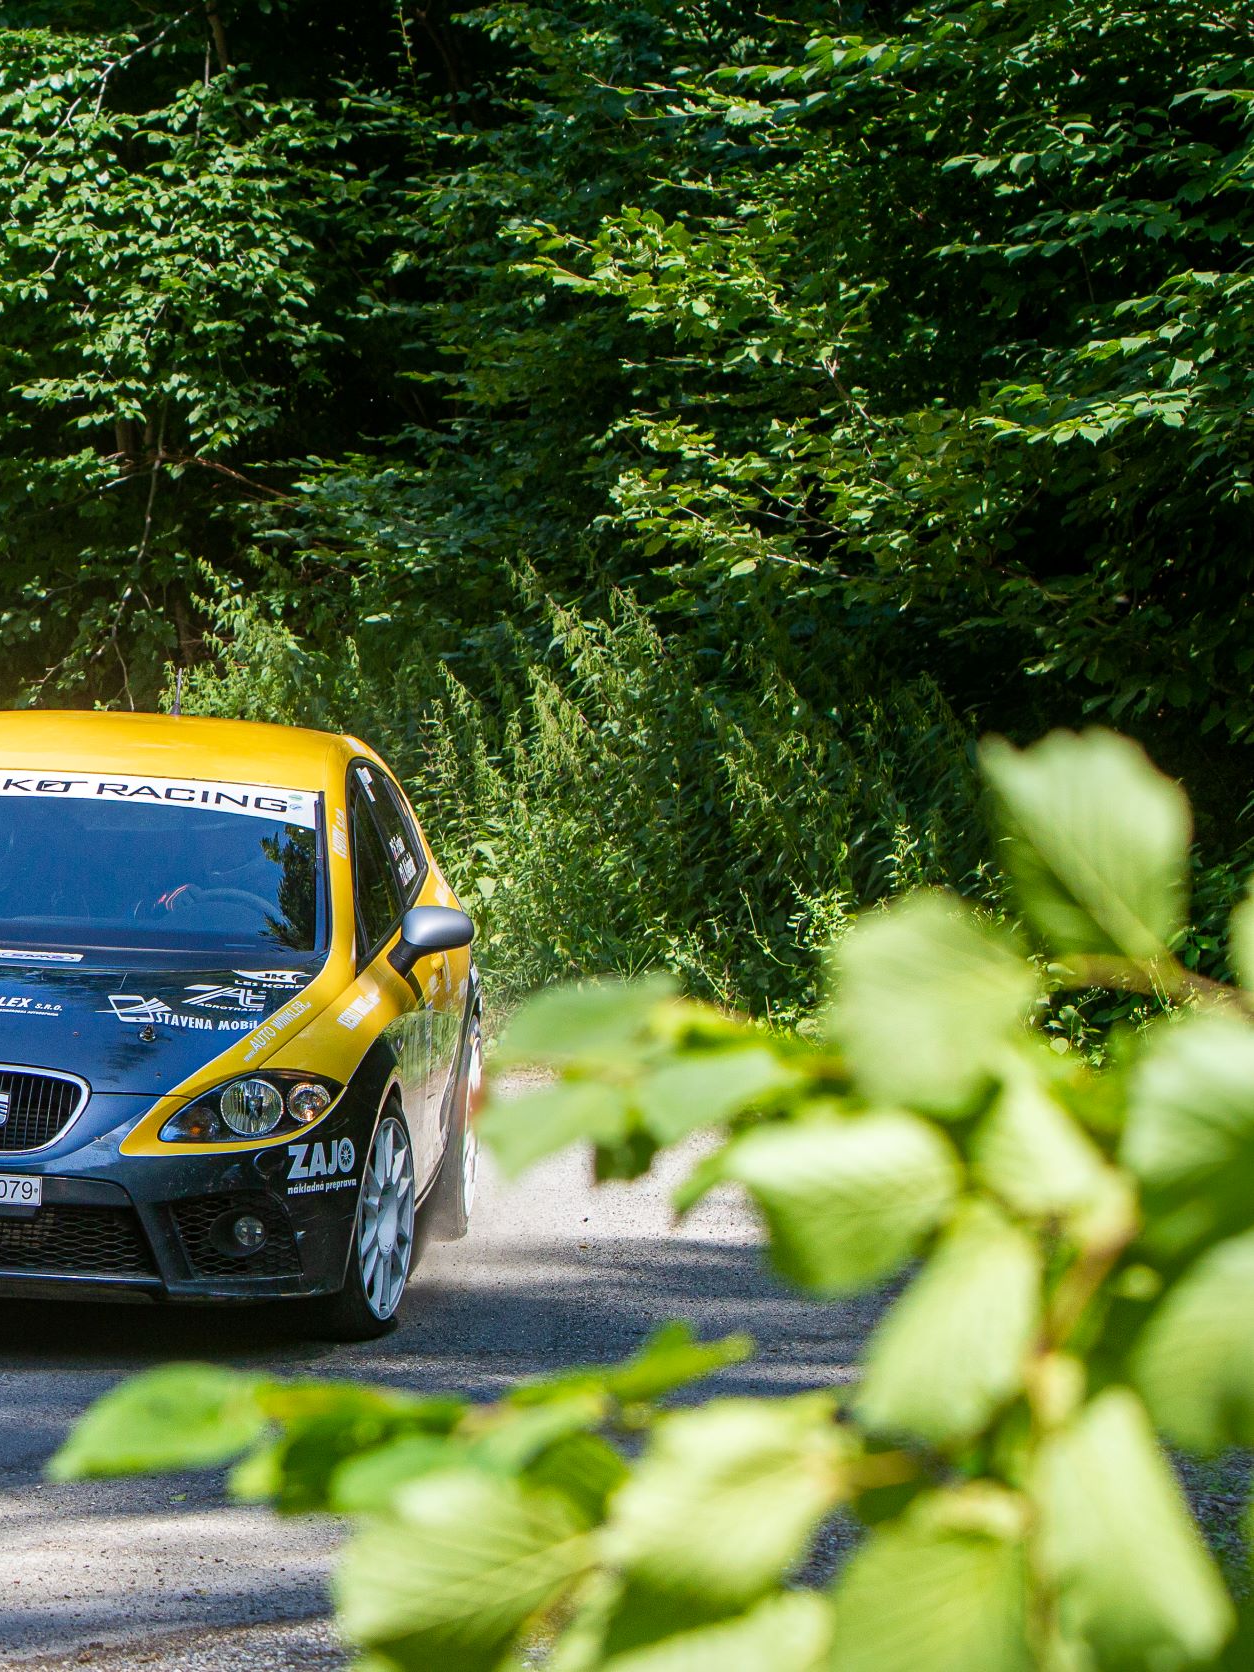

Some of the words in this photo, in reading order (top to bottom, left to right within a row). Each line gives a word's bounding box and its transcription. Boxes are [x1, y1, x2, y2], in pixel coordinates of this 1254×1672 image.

[96, 783, 288, 813] RACING
[155, 1012, 213, 1031] STAVENA
[287, 1137, 356, 1180] ZAJO
[287, 1181, 324, 1195] nákladná
[325, 1178, 357, 1192] preprava
